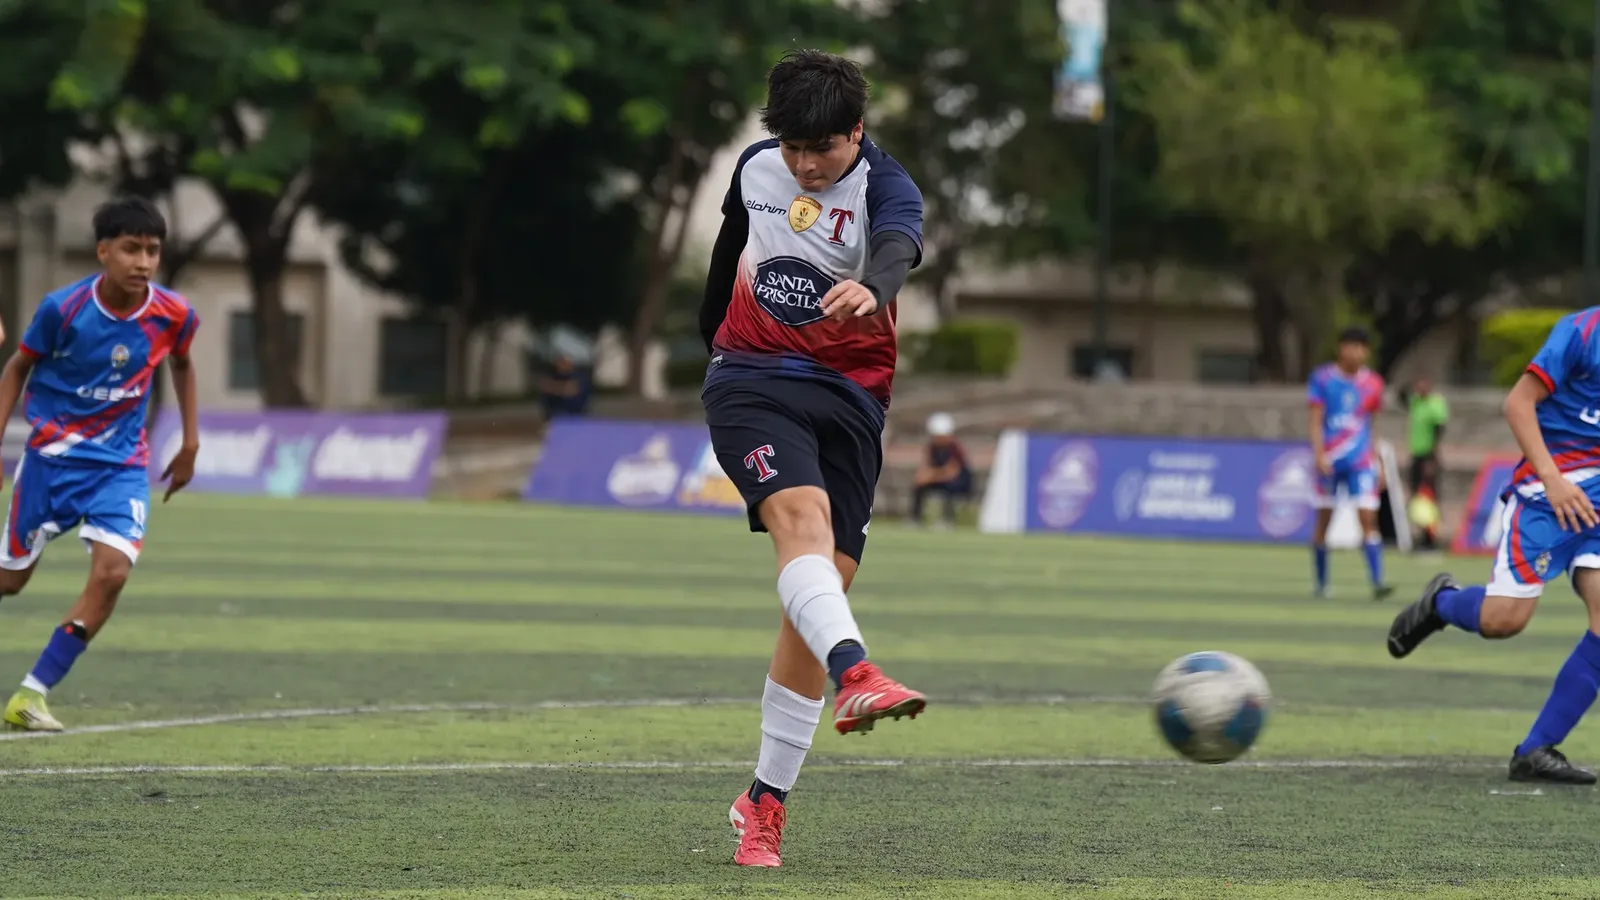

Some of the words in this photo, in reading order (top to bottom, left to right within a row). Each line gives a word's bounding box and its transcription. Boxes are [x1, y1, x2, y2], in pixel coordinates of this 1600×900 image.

[746, 199, 787, 215] elohim
[828, 207, 855, 247] T
[766, 271, 818, 294] SANTA
[756, 283, 825, 310] PRISCILA
[743, 444, 779, 483] T
